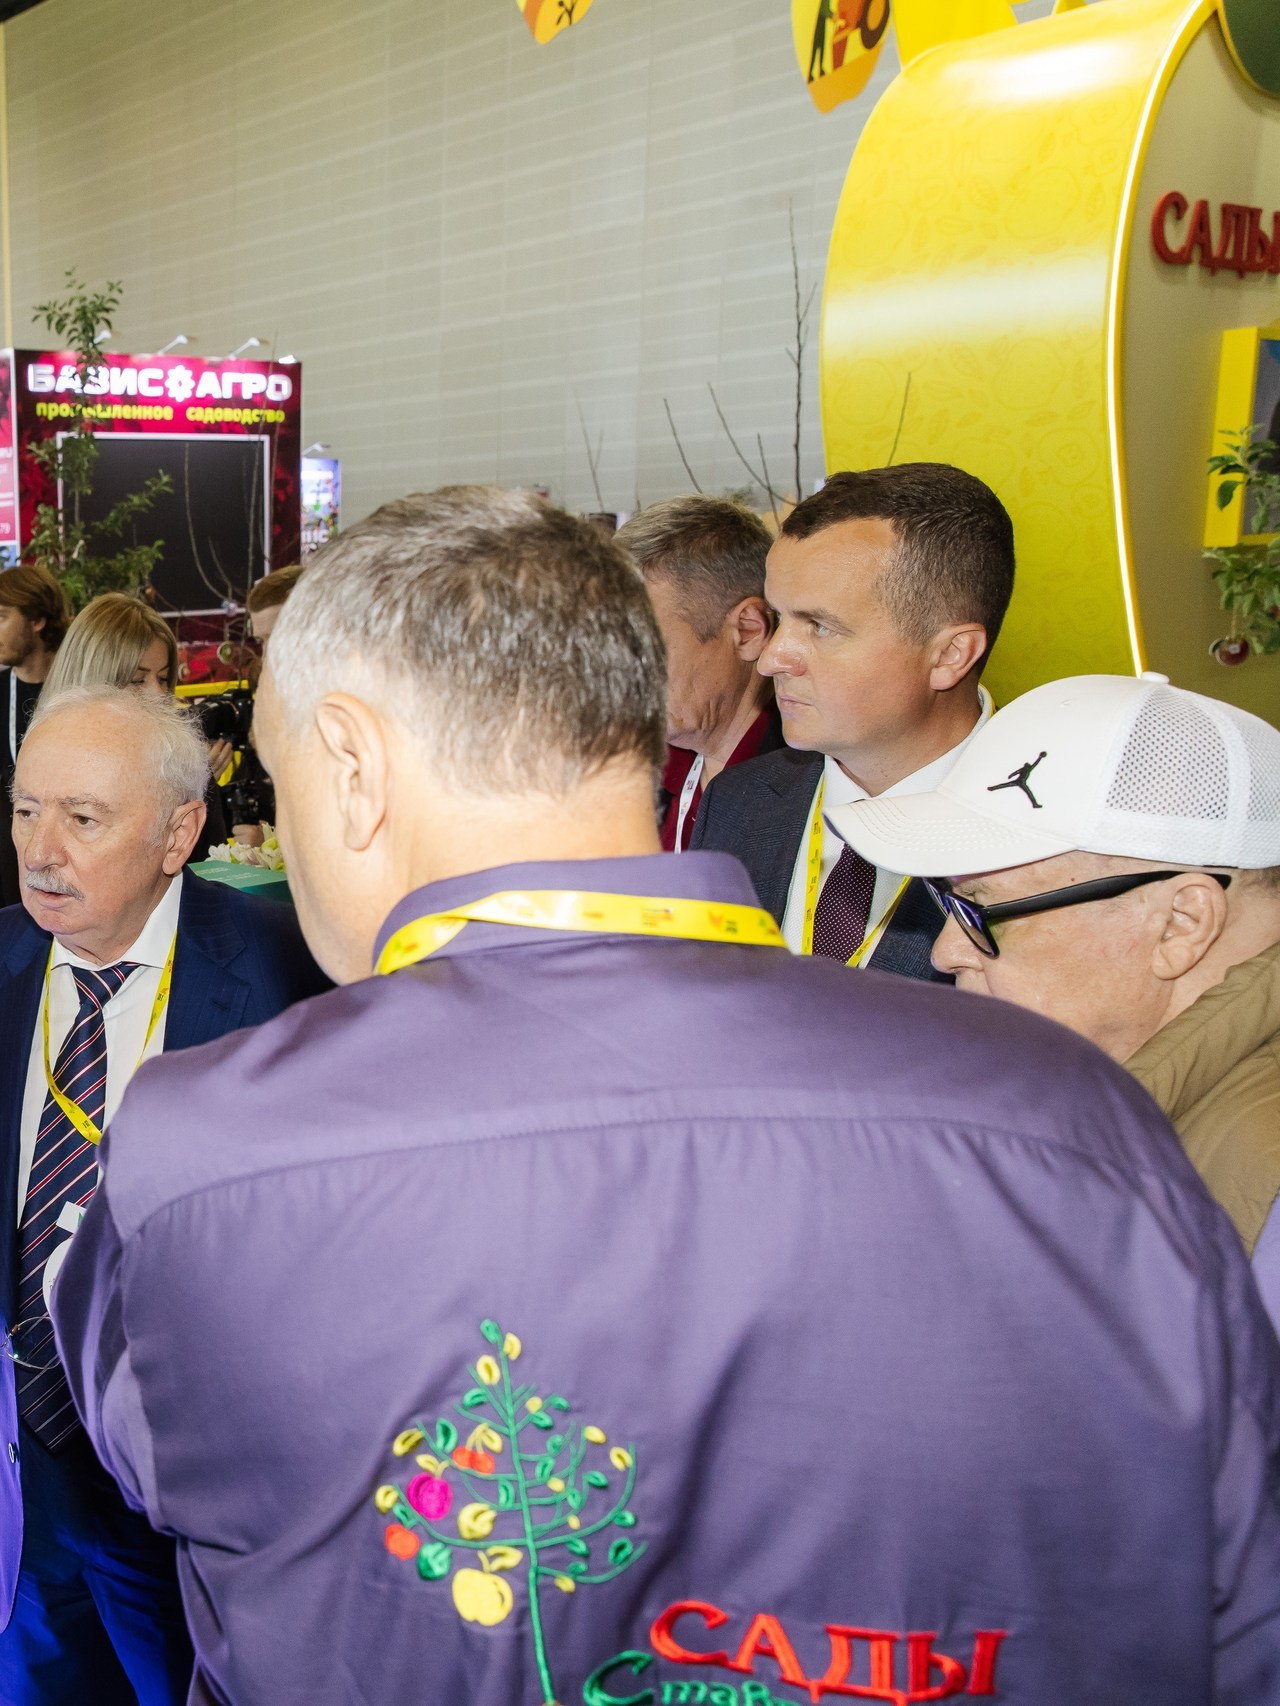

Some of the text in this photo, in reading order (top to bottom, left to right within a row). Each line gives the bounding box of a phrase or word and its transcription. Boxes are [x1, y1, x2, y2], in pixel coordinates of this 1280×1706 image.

[1151, 191, 1280, 279] САДЫ
[27, 363, 292, 401] БАЗИС АГРО
[186, 406, 285, 425] садоводство
[650, 1600, 1008, 1706] САДЫ
